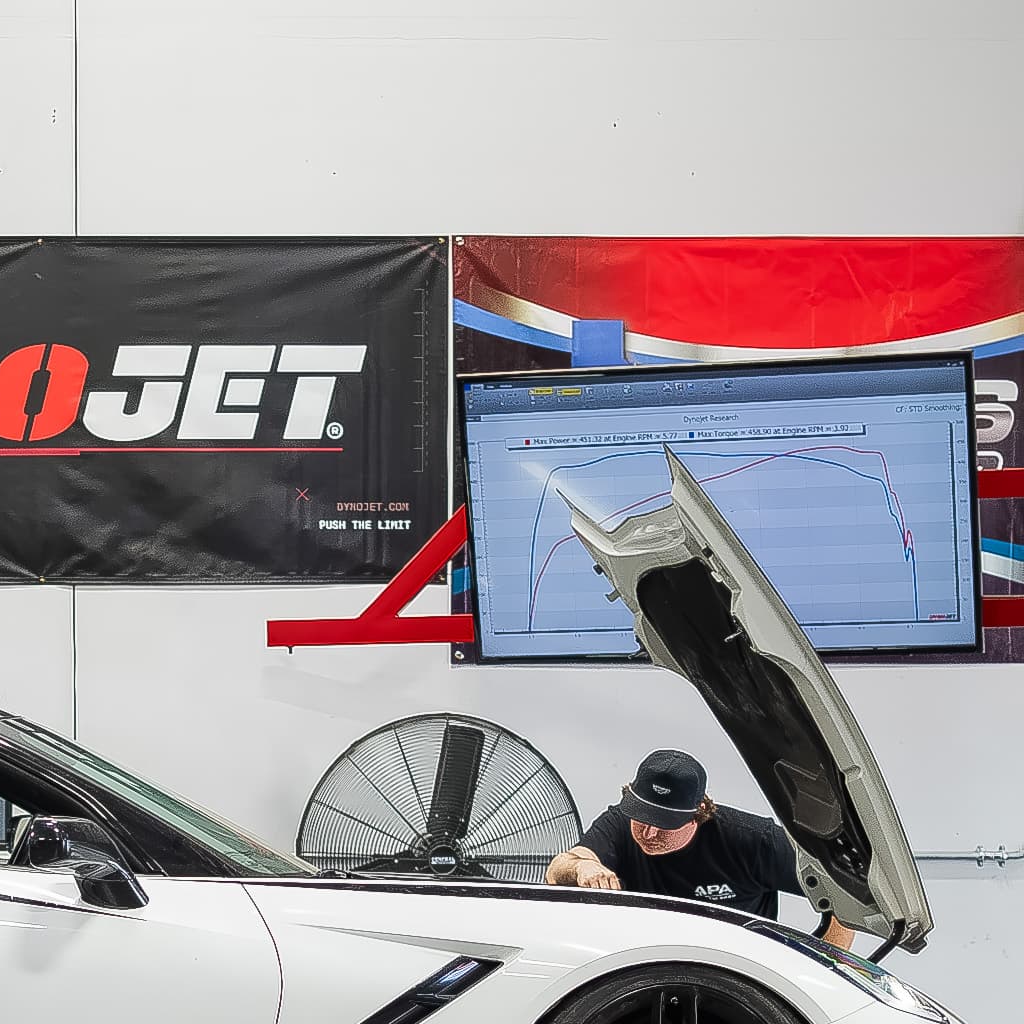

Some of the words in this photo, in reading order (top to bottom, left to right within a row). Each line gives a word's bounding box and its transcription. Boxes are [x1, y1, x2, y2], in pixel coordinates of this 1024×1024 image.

[782, 427, 807, 436] Engine
[336, 502, 410, 512] DYNOJET.COM
[318, 520, 347, 530] PUSH
[351, 520, 372, 530] THE
[377, 520, 412, 530] LIMIT
